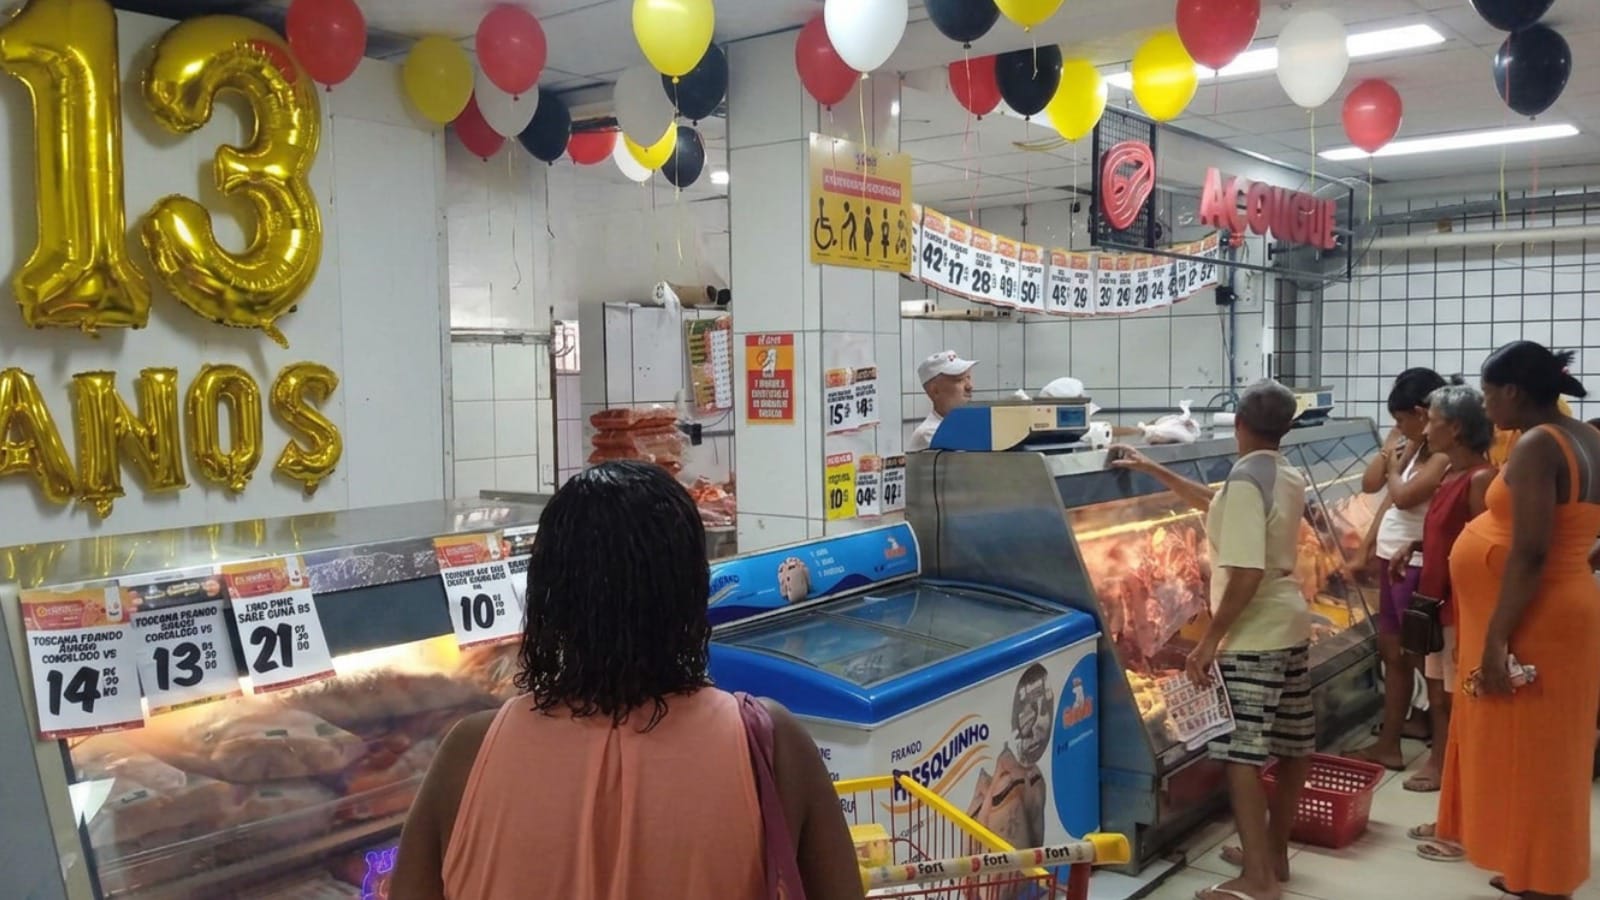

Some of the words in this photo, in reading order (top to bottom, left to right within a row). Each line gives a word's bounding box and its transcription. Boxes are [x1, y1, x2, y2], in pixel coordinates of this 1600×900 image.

[0, 0, 322, 335] 13
[1200, 167, 1337, 249] AÇOUGUE
[923, 242, 943, 273] 42
[948, 259, 964, 285] 17
[972, 268, 991, 294] 28
[1021, 280, 1037, 305] 50
[1073, 287, 1088, 309] 29
[829, 403, 844, 426] 15
[0, 362, 343, 517] ANOS
[830, 488, 843, 510] 10
[461, 593, 494, 632] 10
[250, 622, 293, 674] 21
[153, 642, 204, 691] 13
[47, 666, 102, 716] 14
[983, 854, 1009, 866] fort
